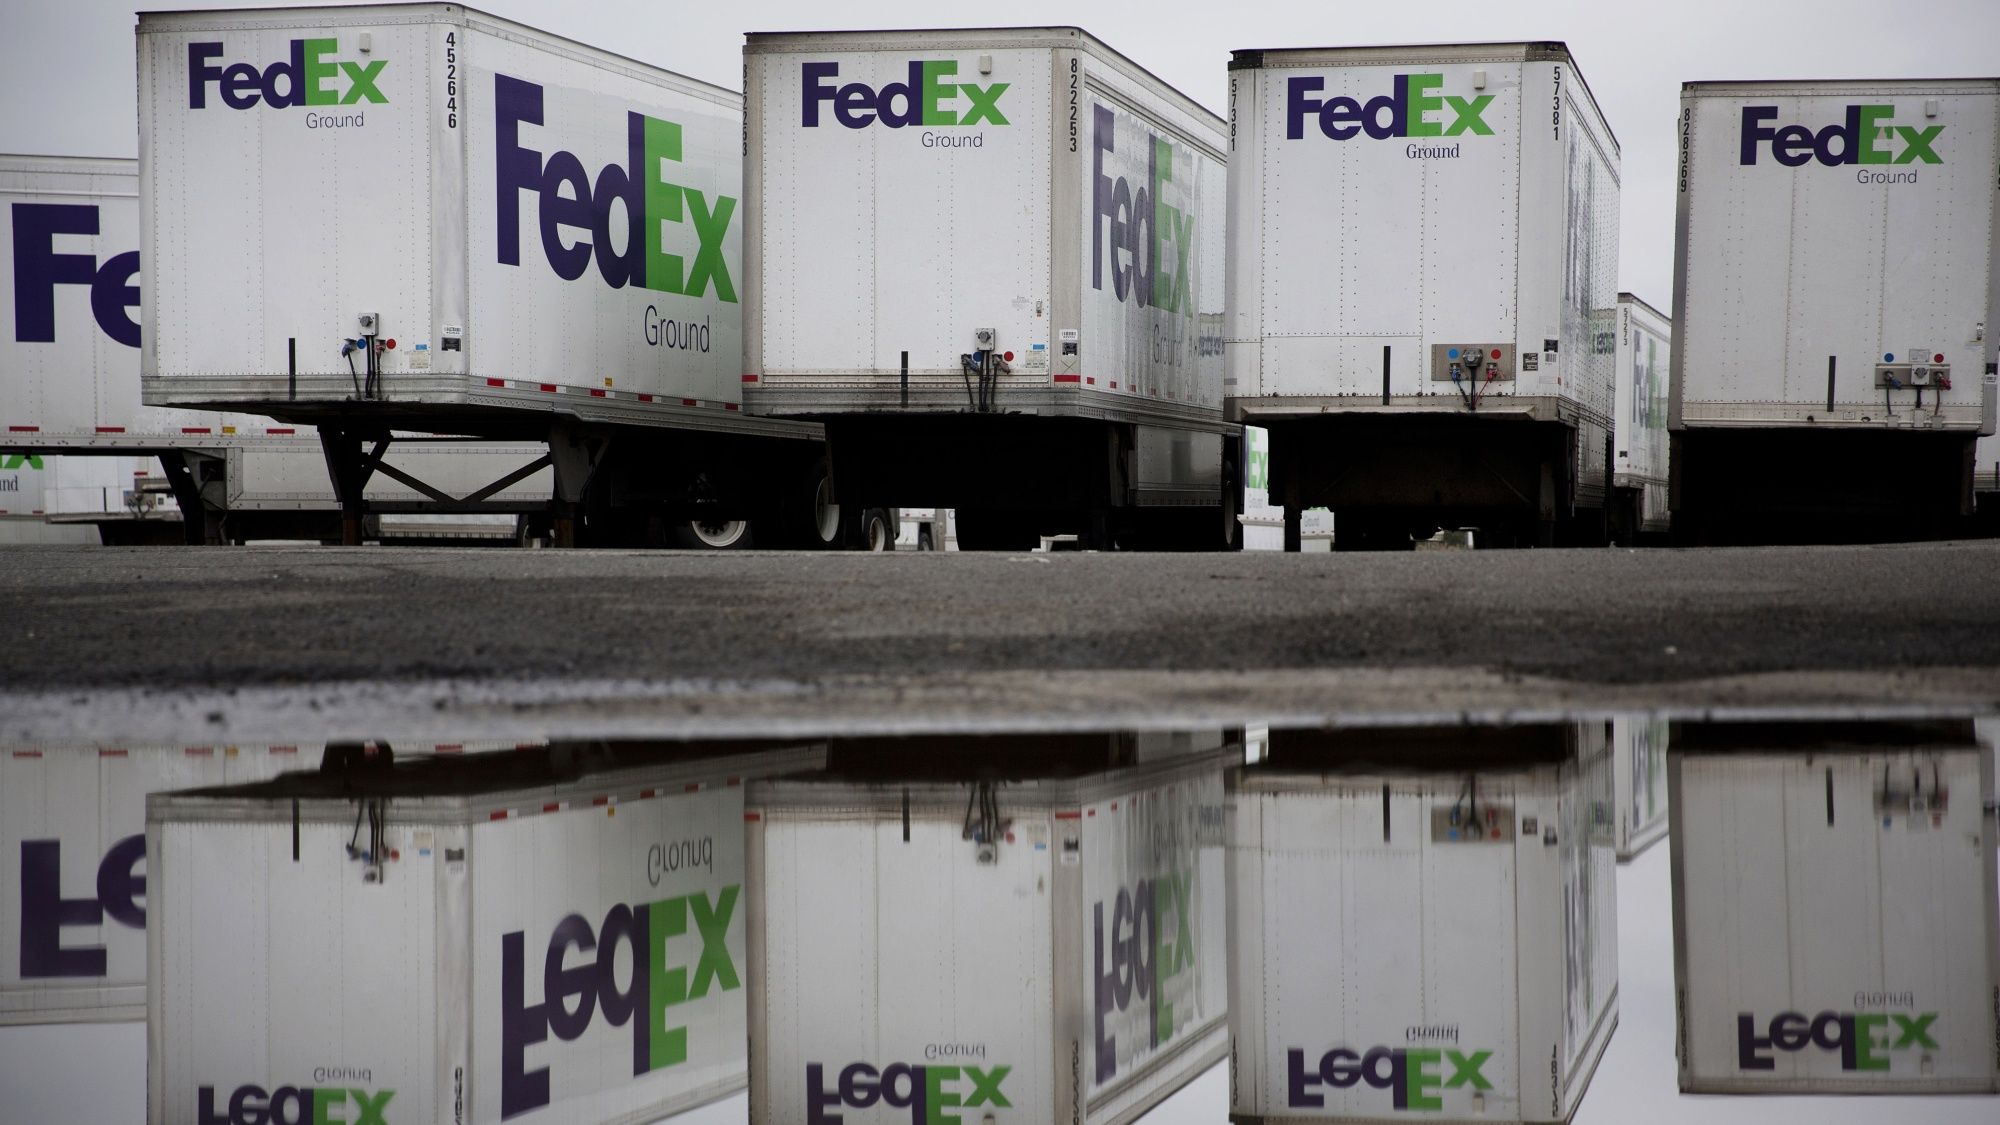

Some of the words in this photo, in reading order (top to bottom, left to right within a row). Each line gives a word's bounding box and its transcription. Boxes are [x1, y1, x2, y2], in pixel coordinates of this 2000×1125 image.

[188, 39, 389, 110] FedEx
[445, 32, 457, 129] 452646
[802, 60, 1010, 129] FedEx
[1069, 57, 1078, 153] 822253
[1287, 73, 1496, 140] FedEx
[305, 112, 364, 129] Ground
[921, 131, 983, 148] Ground
[1230, 78, 1239, 152] 57381
[1740, 104, 1945, 166] FedEx
[1406, 143, 1460, 160] Ground
[1680, 108, 1690, 192] 828369
[1857, 169, 1917, 184] Ground
[494, 73, 738, 303] FedEx
[1093, 103, 1194, 317] FedEx
[644, 304, 710, 354] Ground
